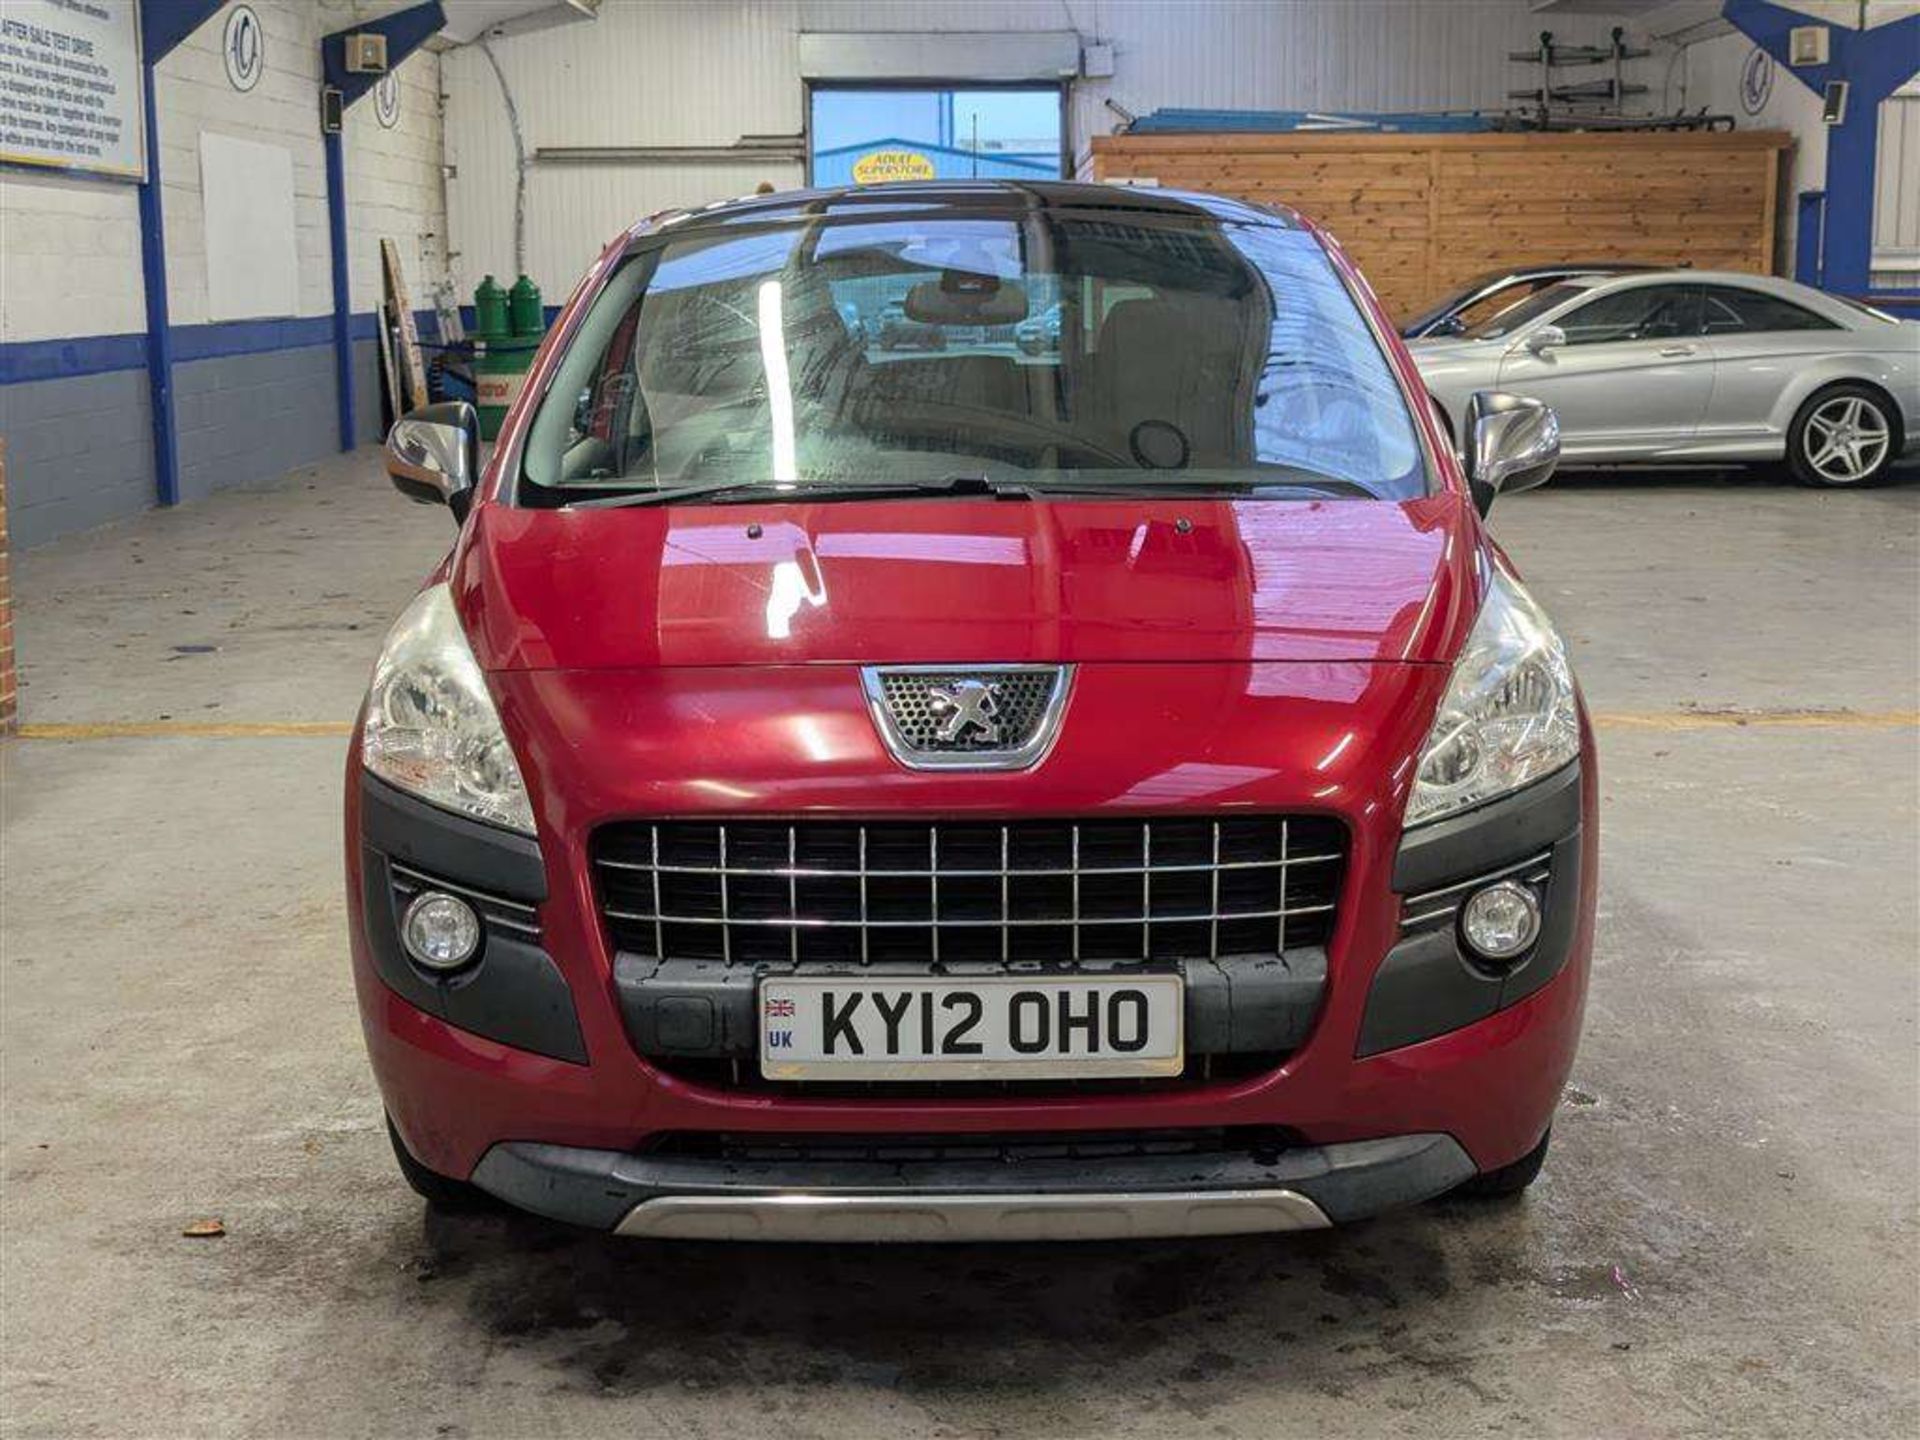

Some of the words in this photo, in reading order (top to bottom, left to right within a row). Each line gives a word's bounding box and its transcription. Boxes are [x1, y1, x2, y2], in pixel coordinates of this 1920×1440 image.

[2, 19, 27, 39] AFTER
[29, 26, 50, 47] SALE
[51, 31, 70, 51] TEST
[72, 37, 94, 58] DRIVE
[769, 1031, 793, 1048] UK
[822, 991, 983, 1055] KY12
[1009, 990, 1149, 1053] OHO
